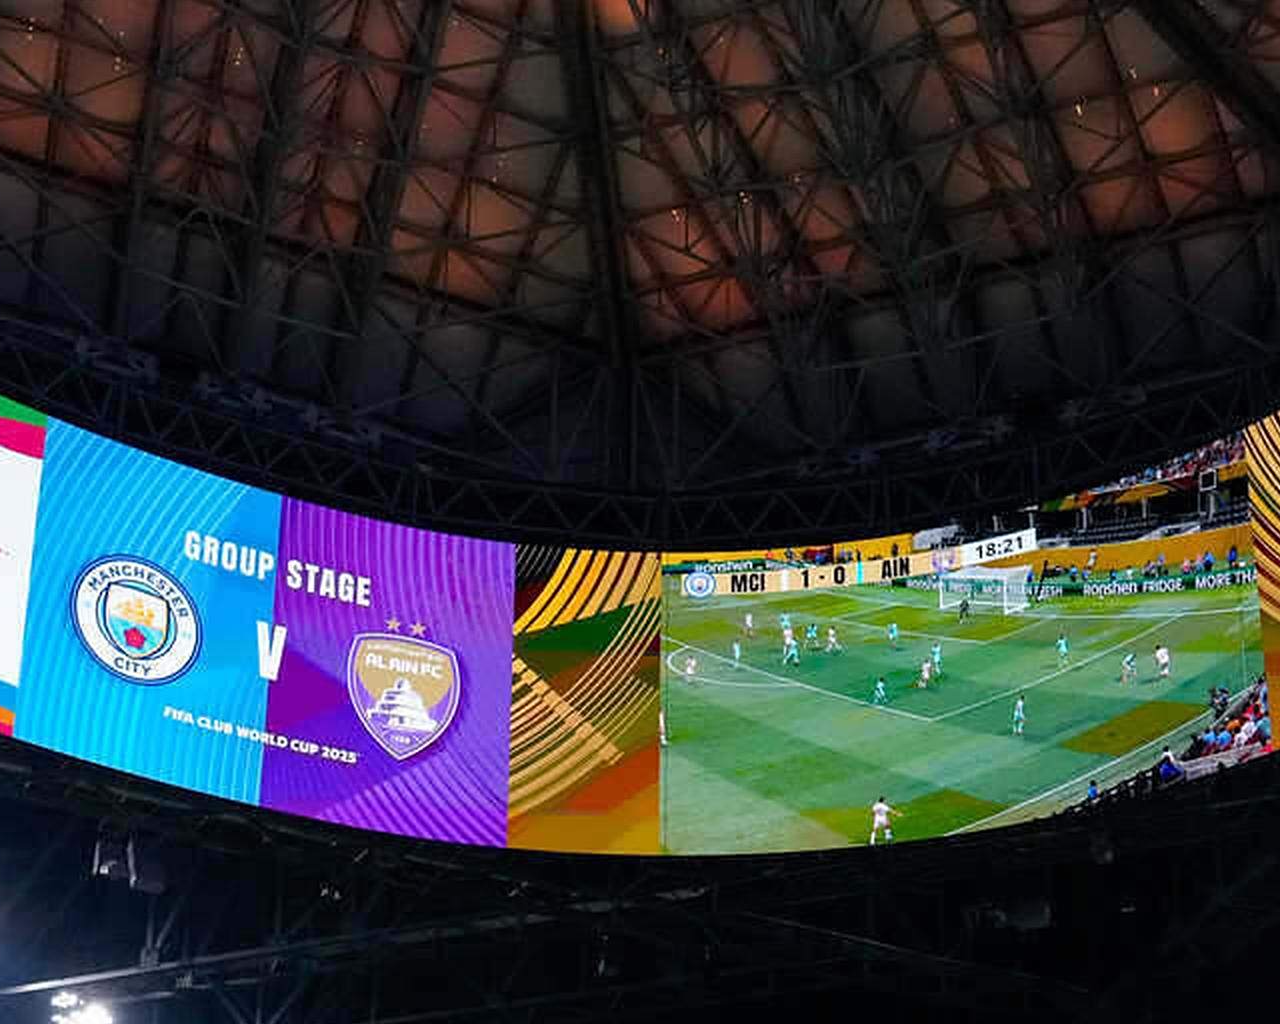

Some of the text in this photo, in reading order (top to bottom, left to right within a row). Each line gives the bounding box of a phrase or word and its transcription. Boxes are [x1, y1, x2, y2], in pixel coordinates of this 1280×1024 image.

[184, 530, 372, 607] GROUP STAGE
[975, 535, 1024, 559] 18:21
[87, 564, 191, 620] MANCHESTER
[730, 573, 765, 593] MCI
[801, 570, 809, 588] 1
[833, 566, 846, 584] 0
[880, 557, 911, 579] AIN
[1142, 578, 1185, 593] FRIDGE
[1195, 572, 1232, 590] MORE
[113, 656, 152, 677] CITY
[256, 620, 287, 682] V
[163, 705, 195, 726] FIFA
[197, 715, 234, 735] CLUB
[236, 724, 288, 749] WORLD
[290, 739, 320, 755] CUP
